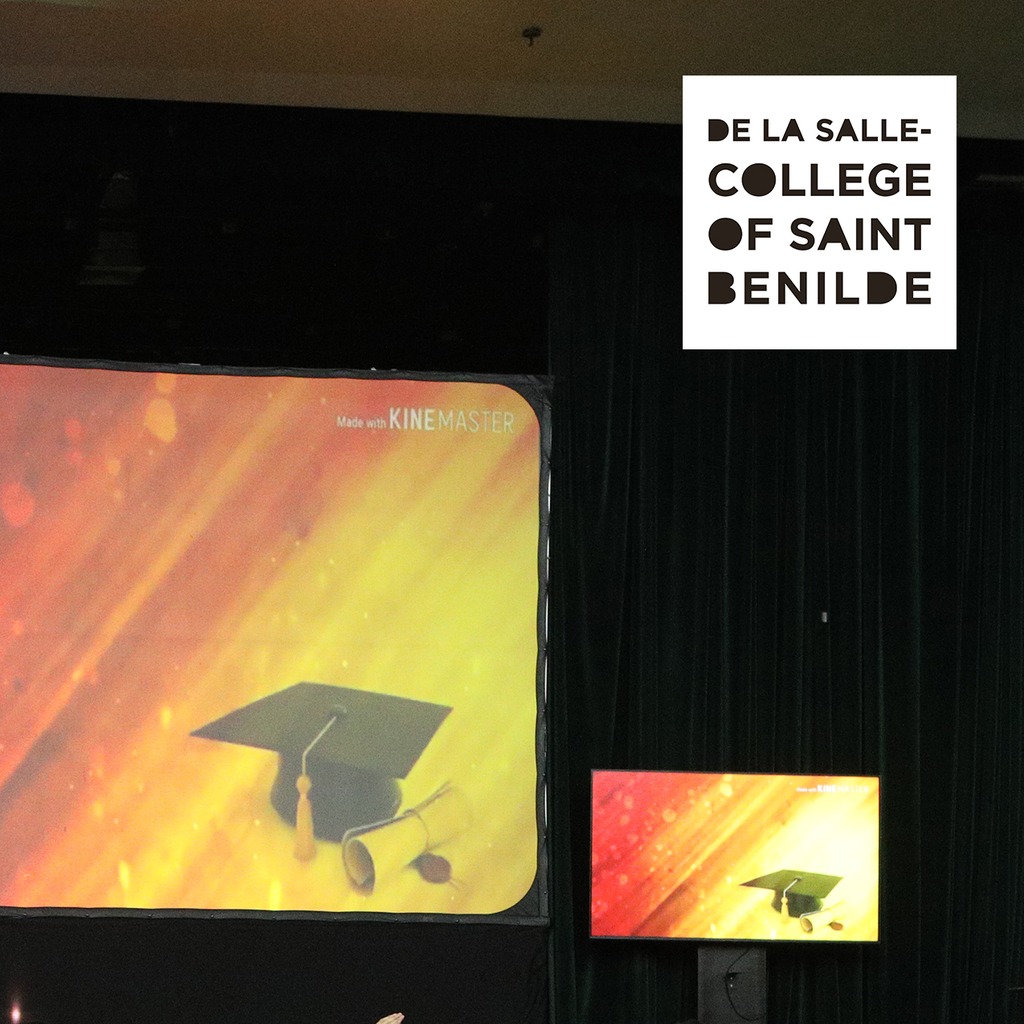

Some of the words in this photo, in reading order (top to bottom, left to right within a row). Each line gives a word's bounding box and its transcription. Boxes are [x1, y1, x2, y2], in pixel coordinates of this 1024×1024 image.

[336, 416, 364, 428] Made
[366, 417, 387, 429] with
[389, 406, 515, 434] KINEMASTER
